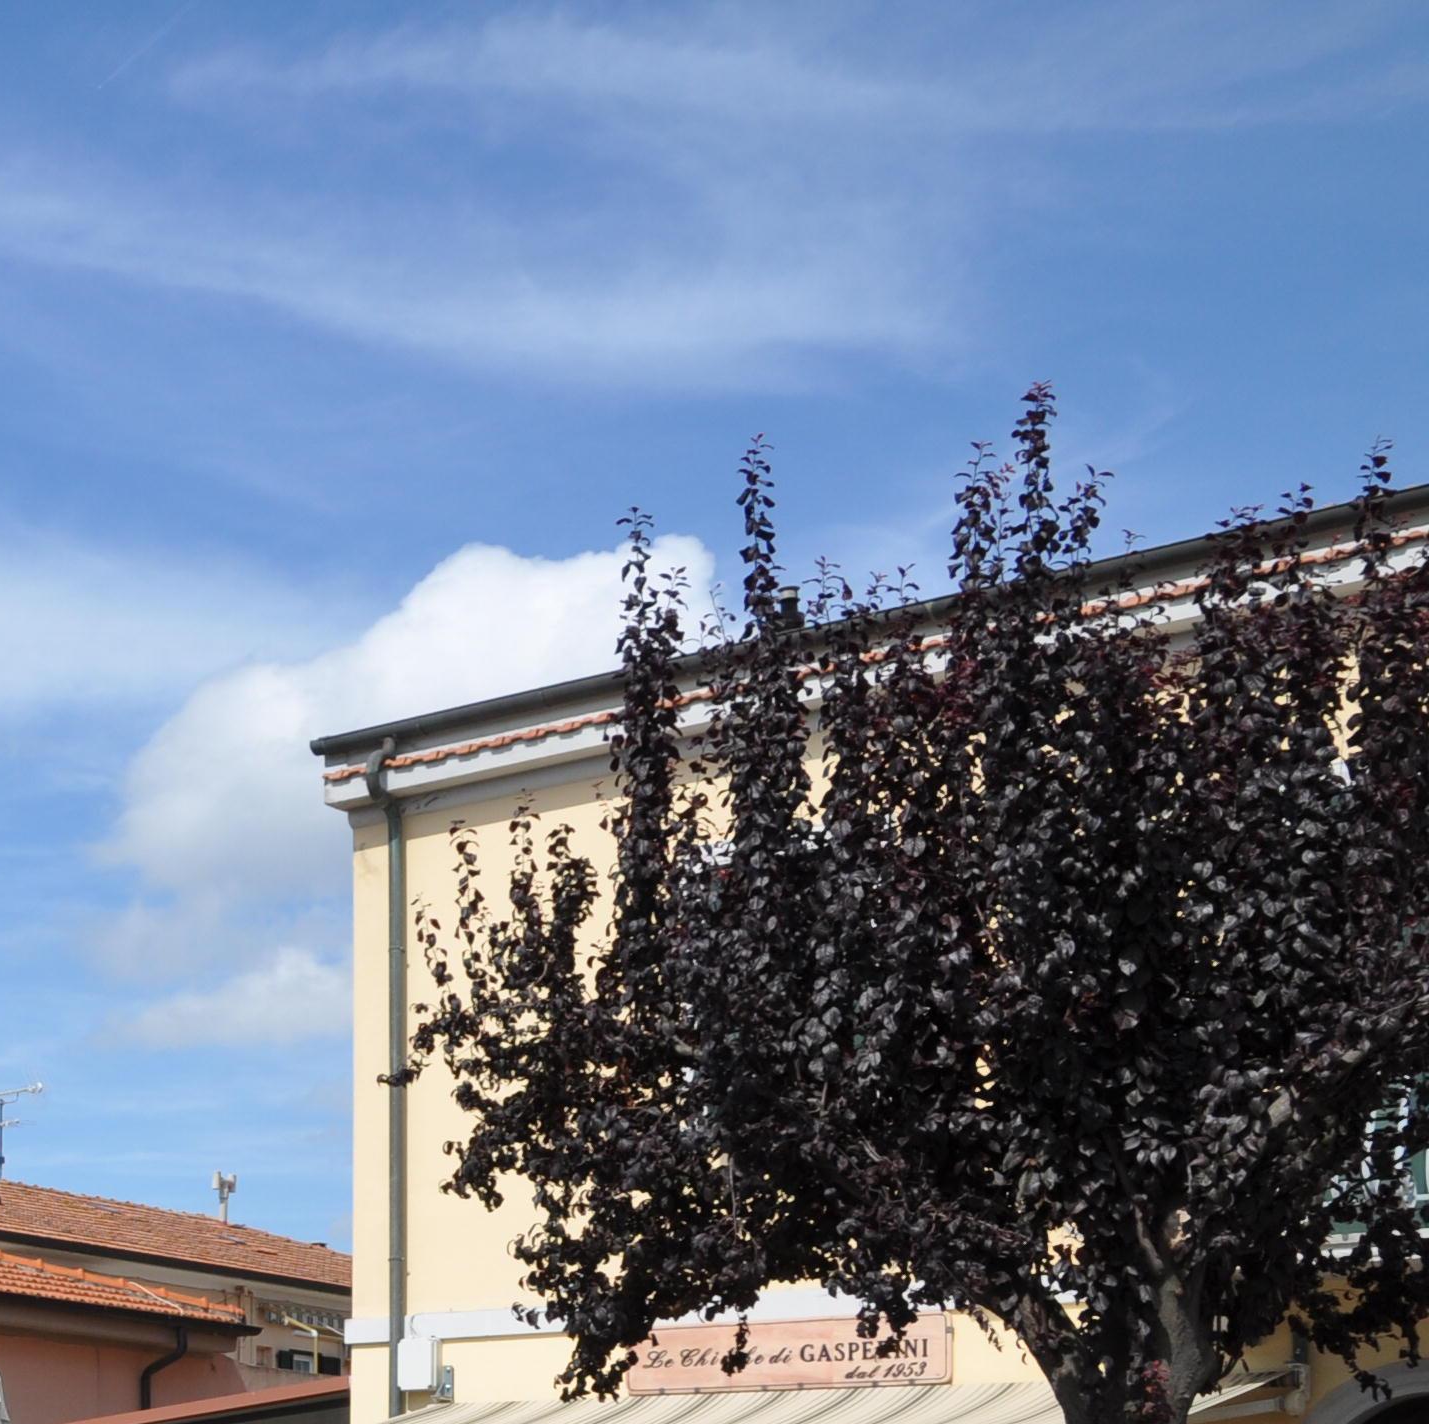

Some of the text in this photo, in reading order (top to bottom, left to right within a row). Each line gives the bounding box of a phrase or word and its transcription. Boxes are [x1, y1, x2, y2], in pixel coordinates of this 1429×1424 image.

[643, 1338, 929, 1368] Le Chihe di GASPEINI
[845, 1361, 928, 1379] dal 1953
